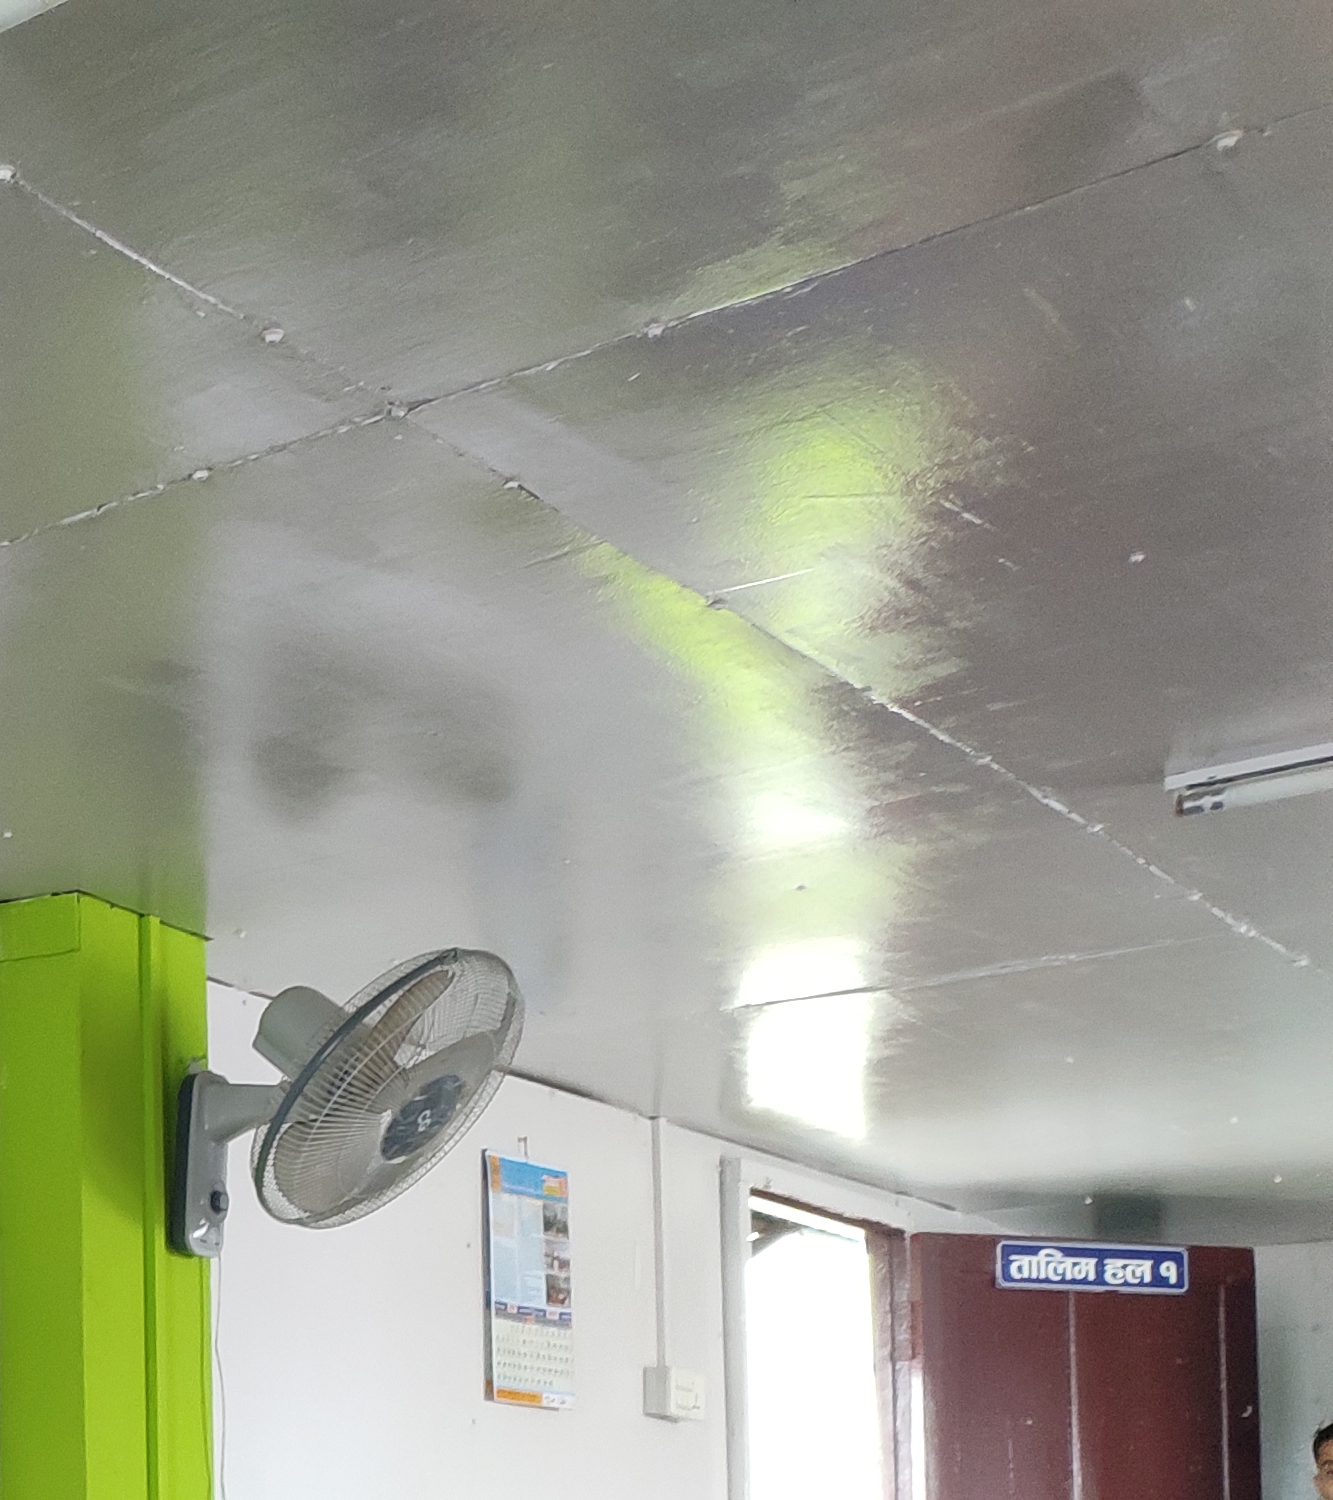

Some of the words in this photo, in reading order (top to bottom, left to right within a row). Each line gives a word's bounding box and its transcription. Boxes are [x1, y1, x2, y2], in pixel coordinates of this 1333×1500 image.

[1009, 1249, 1098, 1281] तालिम
[1103, 1257, 1154, 1285] हल
[1159, 1260, 1178, 1285] १
